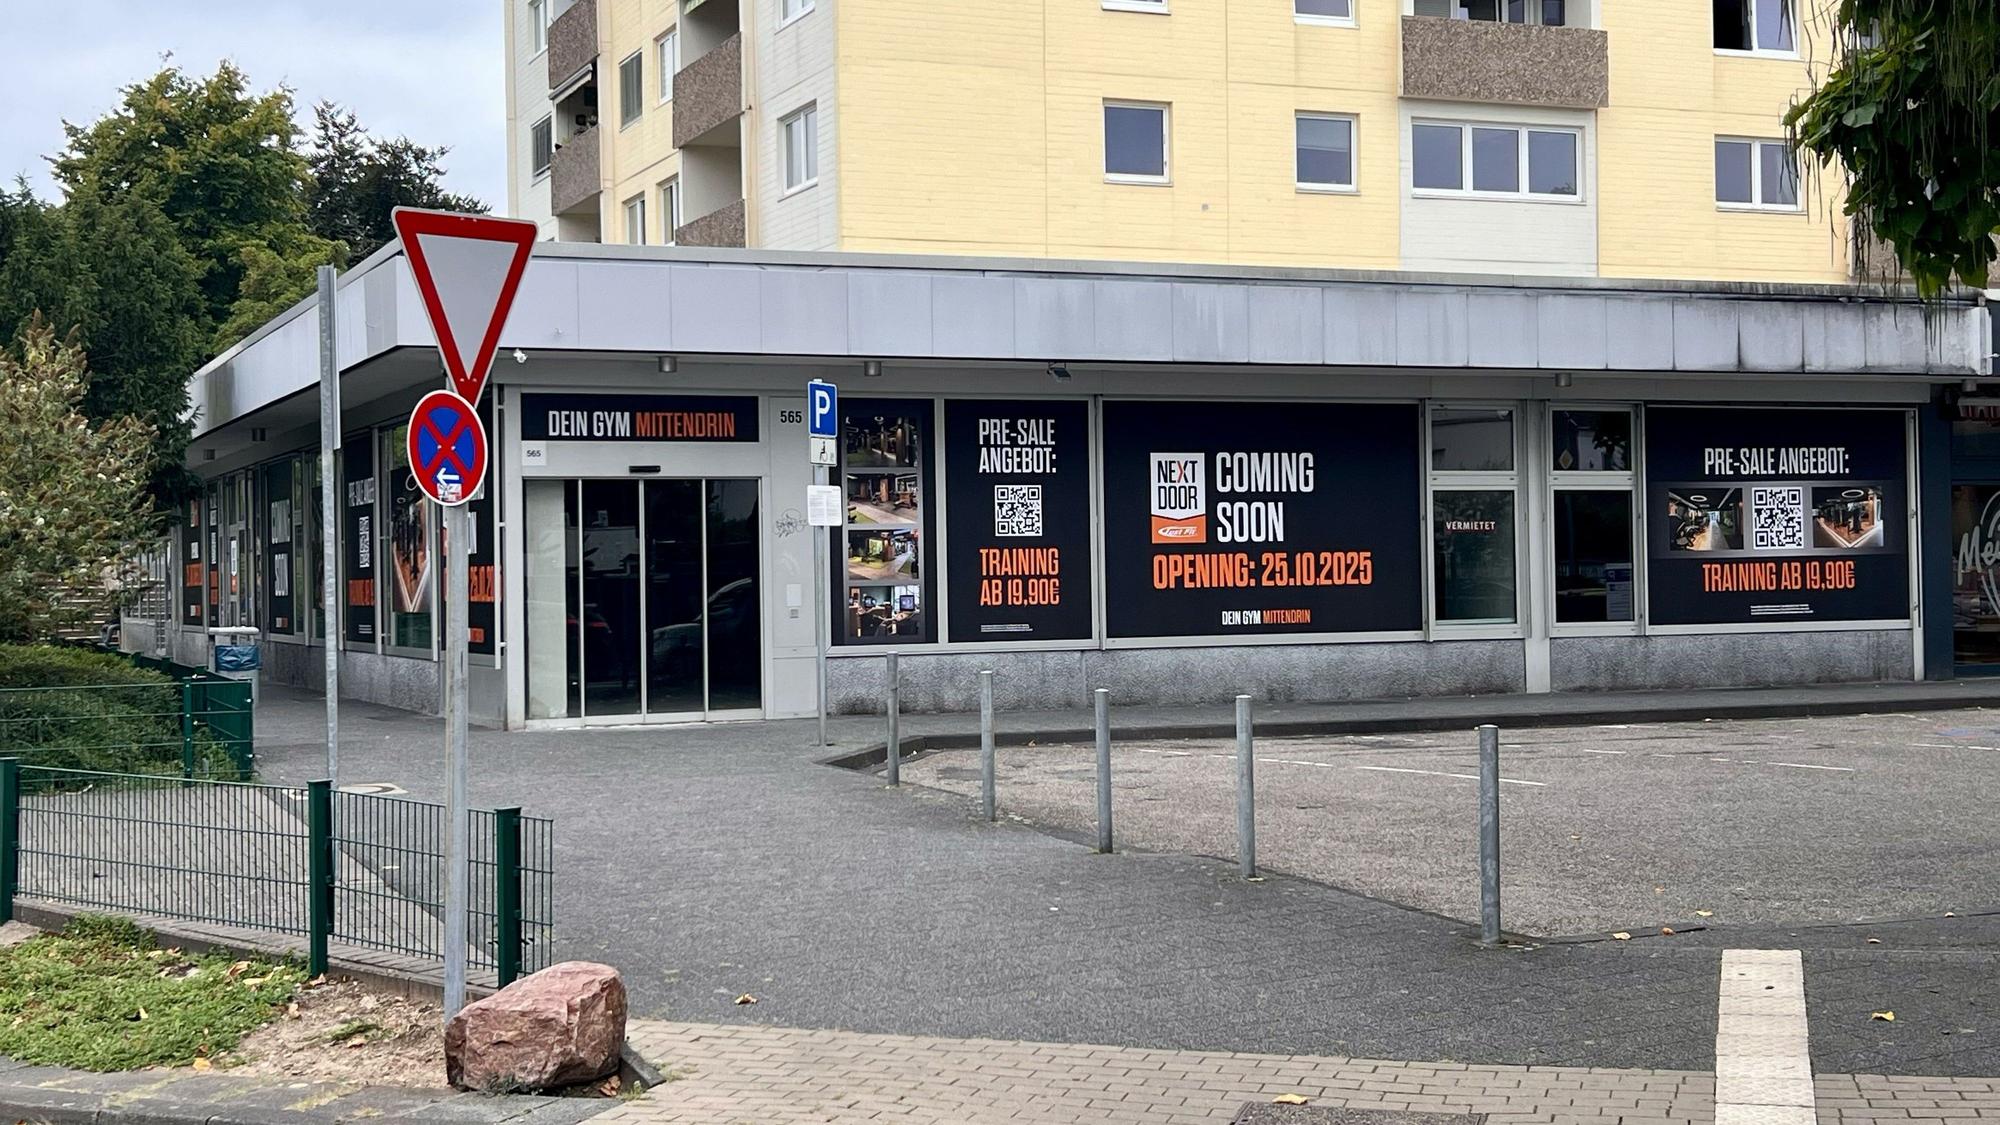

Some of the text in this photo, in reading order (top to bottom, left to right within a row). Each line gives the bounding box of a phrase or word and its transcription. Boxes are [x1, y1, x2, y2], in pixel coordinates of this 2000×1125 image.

[780, 411, 802, 424] 565
[815, 390, 831, 429] P
[548, 410, 735, 438] DEIN GYM MITTENDRIN
[979, 418, 1056, 446] PRE-SALE
[526, 449, 541, 458] 565
[979, 447, 1057, 474] ANGEBOT:
[1704, 447, 1850, 475] PRE-SALE ANGEBOT:
[1157, 460, 1198, 483] NEXT
[1215, 452, 1314, 493] COMING
[1158, 486, 1198, 510] DOOR
[1216, 501, 1284, 543] SOON
[1446, 520, 1496, 531] VERMIETET
[980, 547, 1059, 576] TRAINING
[1153, 551, 1373, 590] OPENING: 25.10.2025
[1702, 560, 1856, 592] TRAINING AB 19,90€
[980, 578, 1060, 607] AB 19,90€
[1222, 609, 1311, 625] DEIN GYM MITTENDRIN
